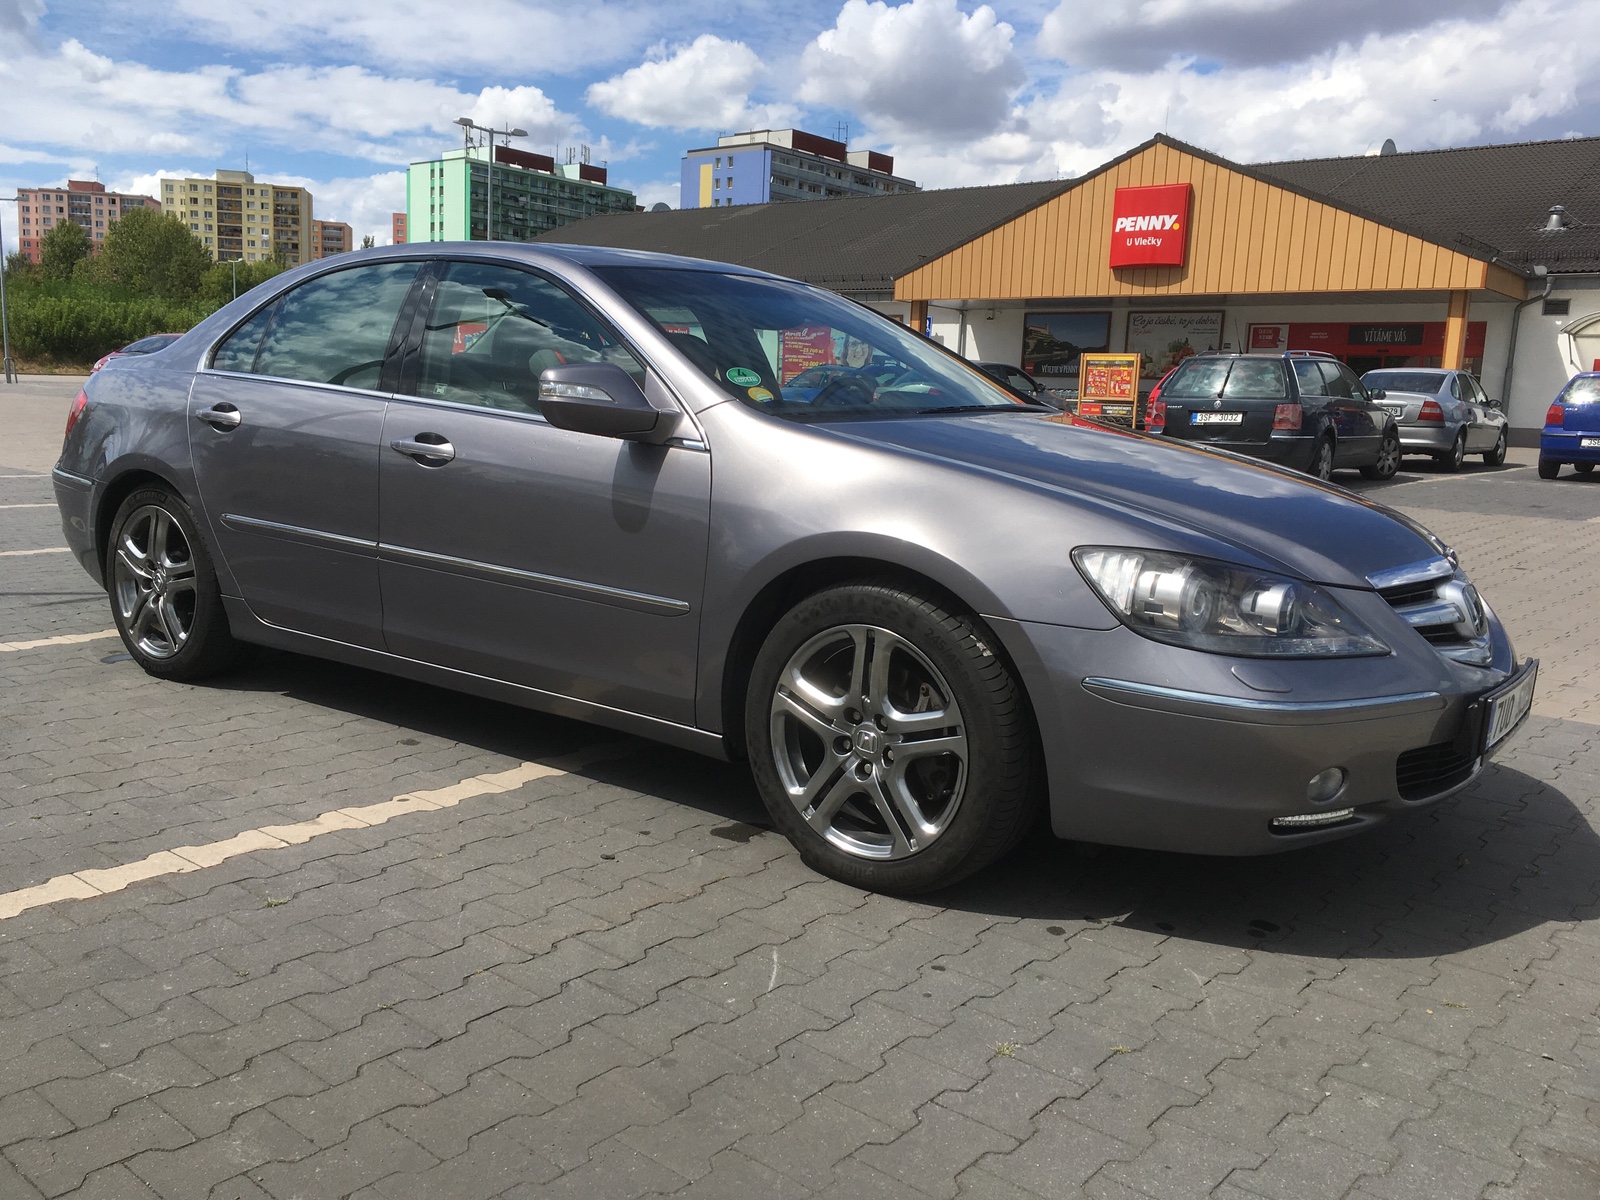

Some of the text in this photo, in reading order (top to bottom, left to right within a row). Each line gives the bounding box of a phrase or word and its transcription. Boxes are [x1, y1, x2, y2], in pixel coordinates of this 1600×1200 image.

[1126, 236, 1163, 247] U Vlečky
[1364, 327, 1407, 342] VÍTÁME VÁS
[1198, 413, 1239, 422] 3SF 3032
